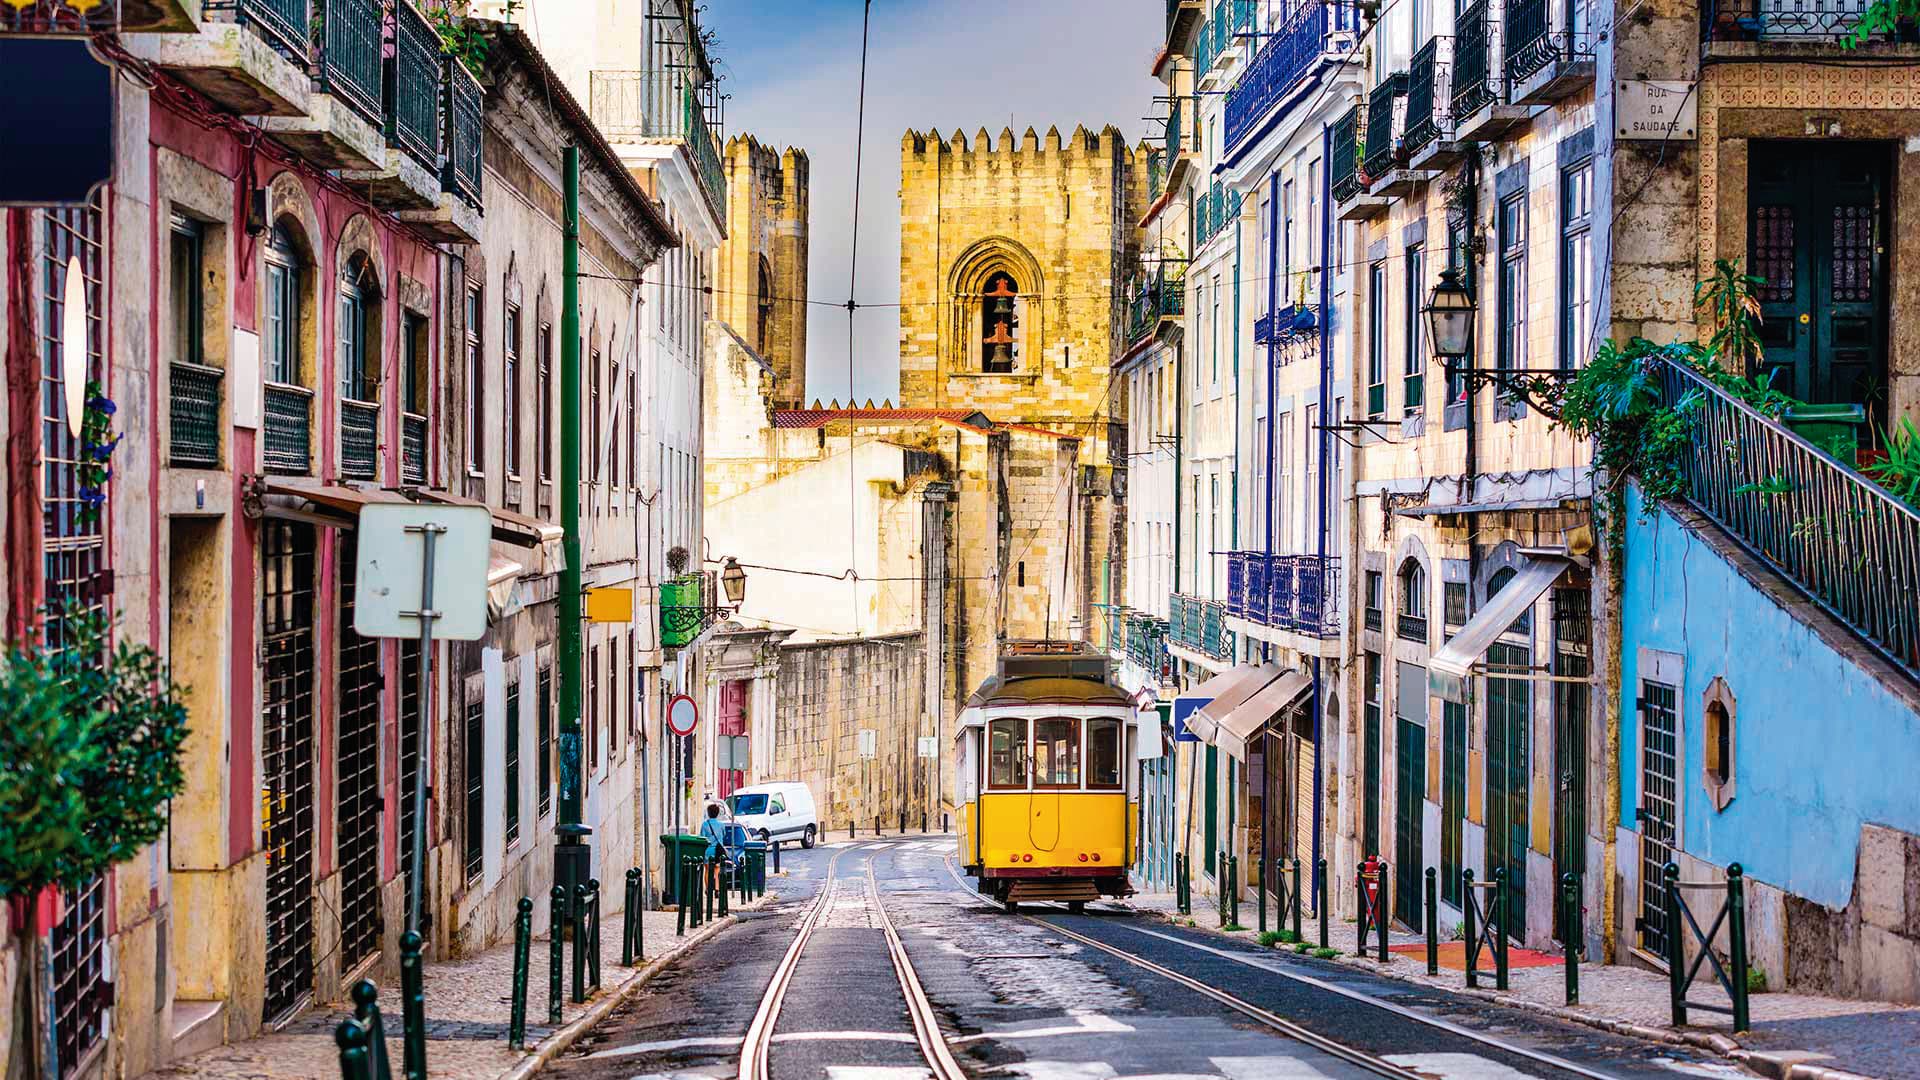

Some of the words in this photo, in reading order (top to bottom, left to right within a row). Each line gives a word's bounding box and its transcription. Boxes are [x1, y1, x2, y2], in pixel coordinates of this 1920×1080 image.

[1648, 88, 1667, 98] RUA
[1650, 105, 1664, 114] DA
[1633, 122, 1680, 131] SAUDADE
